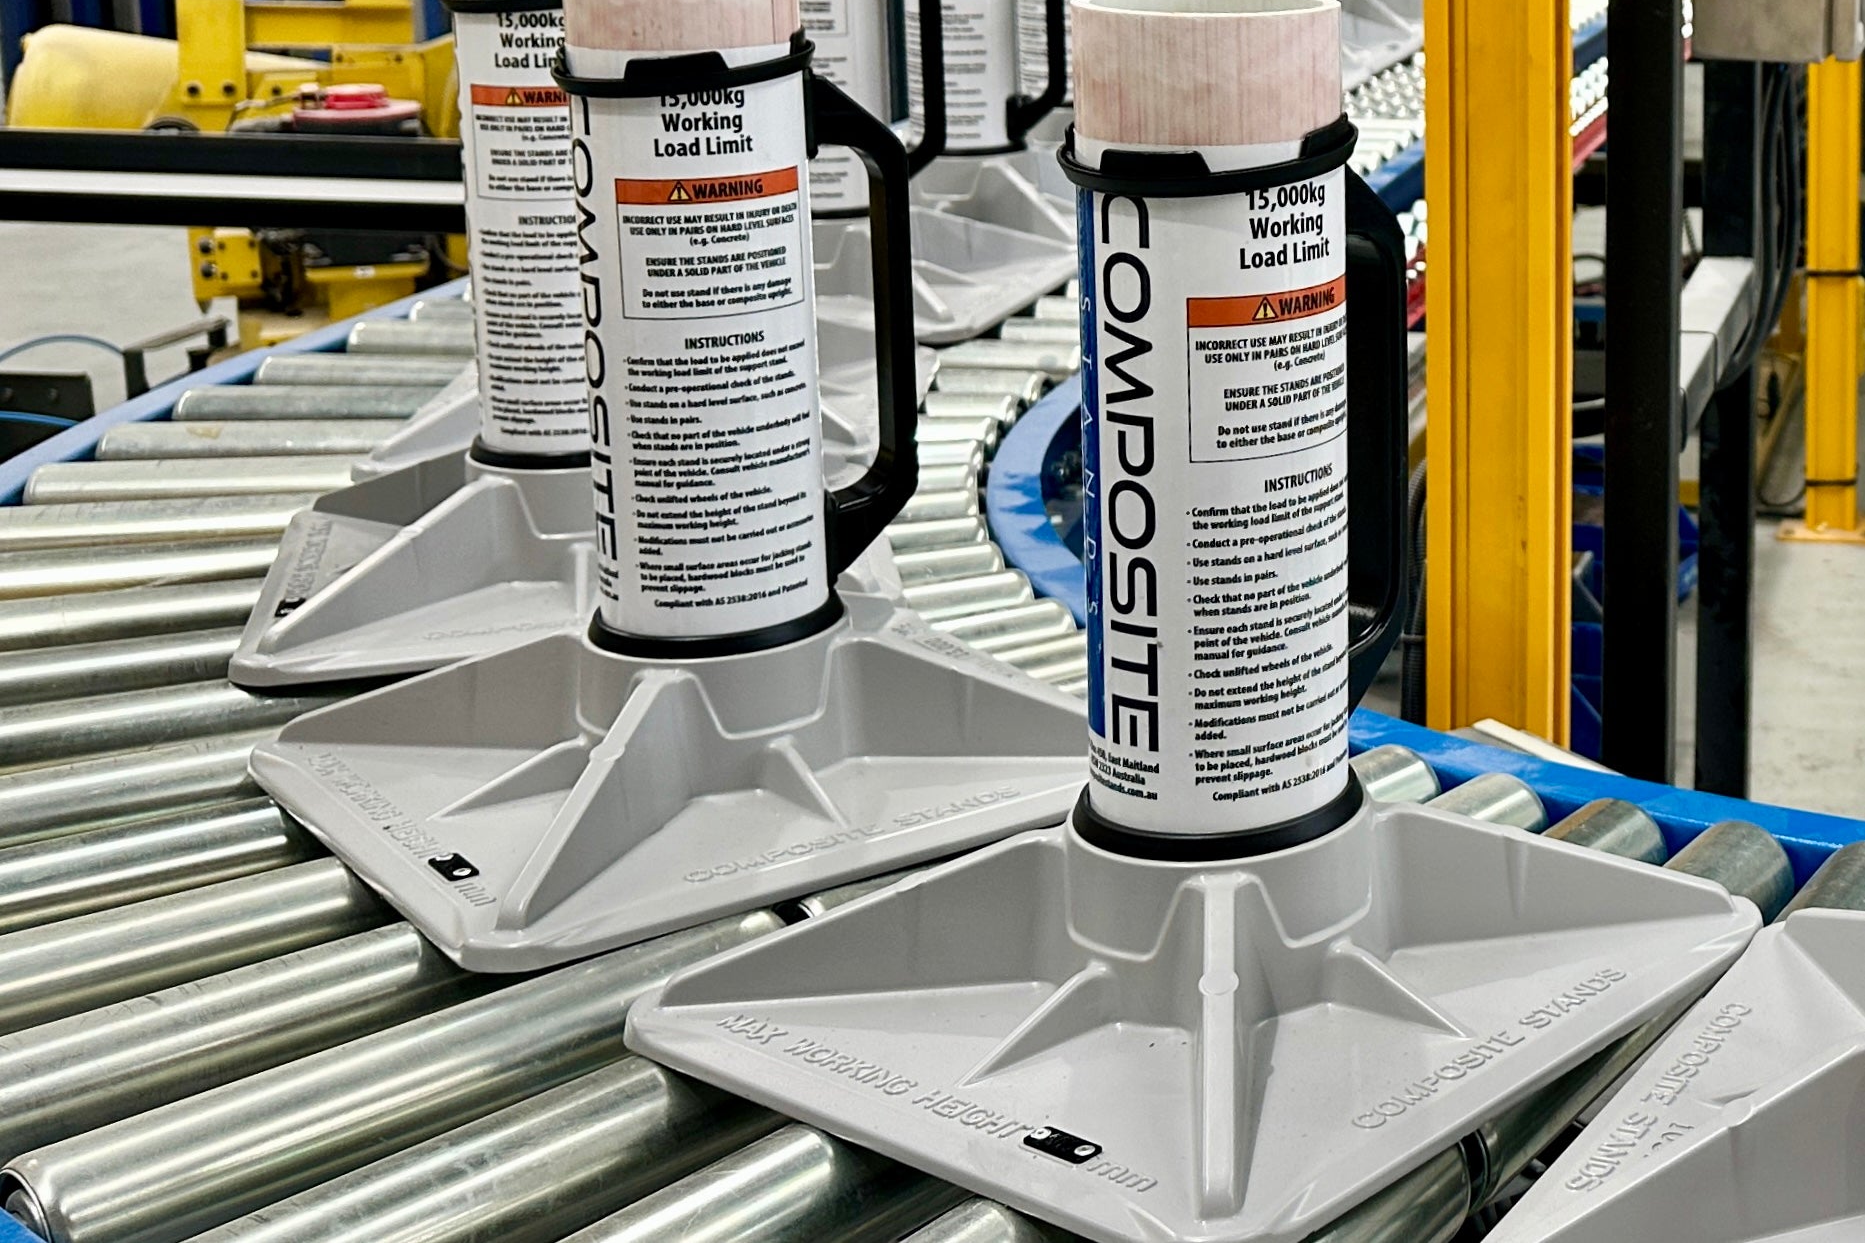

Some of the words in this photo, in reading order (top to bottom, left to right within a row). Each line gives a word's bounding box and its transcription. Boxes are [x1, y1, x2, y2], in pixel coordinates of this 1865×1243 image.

[494, 52, 530, 68] Load
[523, 91, 567, 104] WARNI
[661, 111, 743, 133] Working
[654, 137, 701, 157] Load
[706, 134, 753, 156] Limit
[692, 179, 763, 199] WARNING
[1245, 182, 1326, 212] 15,000kg
[1249, 212, 1324, 239] Working
[1240, 243, 1288, 269] Load
[1293, 237, 1330, 263] Limit
[1279, 287, 1335, 316] WARNING
[684, 330, 764, 349] INSTRUCTIONS
[1195, 339, 1248, 350] INCORRECT
[1250, 337, 1266, 347] USE
[1269, 334, 1286, 345] MAY
[1205, 353, 1222, 363] USE
[1225, 351, 1249, 362] ONLY
[1252, 351, 1260, 360] IN
[1263, 347, 1288, 359] PAIRS
[1223, 386, 1259, 398] ENSURE
[1262, 384, 1278, 394] THE
[1280, 378, 1308, 392] STANDS
[1225, 399, 1257, 411] UNDER
[1260, 398, 1265, 408] A
[1267, 394, 1290, 407] SOLID
[1293, 390, 1311, 402] PART
[1321, 383, 1330, 394] THE
[1218, 426, 1230, 435] Do
[1232, 425, 1249, 434] not
[1251, 424, 1266, 432] use
[1268, 418, 1292, 430] stand
[1216, 439, 1227, 448] to
[1229, 437, 1257, 447] either
[1260, 434, 1274, 444] the
[1277, 432, 1295, 442] base
[1101, 193, 1159, 752] COMPOSITE
[1264, 463, 1332, 492] INSTRUCTIONS
[1112, 767, 1146, 785] Australia
[1123, 757, 1160, 774] Maitland
[684, 823, 886, 883] COMPOSITE
[893, 785, 1021, 827] STANDS
[1351, 1029, 1526, 1130] COMPOSITE
[1518, 966, 1627, 1030] STANDS
[1640, 1003, 1751, 1106] COMPOSITE
[716, 1011, 788, 1045] MAX
[783, 1035, 919, 1096] WORKING
[912, 1087, 1034, 1141] HEIGHT
[1086, 1158, 1159, 1193] mm
[1565, 1112, 1658, 1192] STANDS
